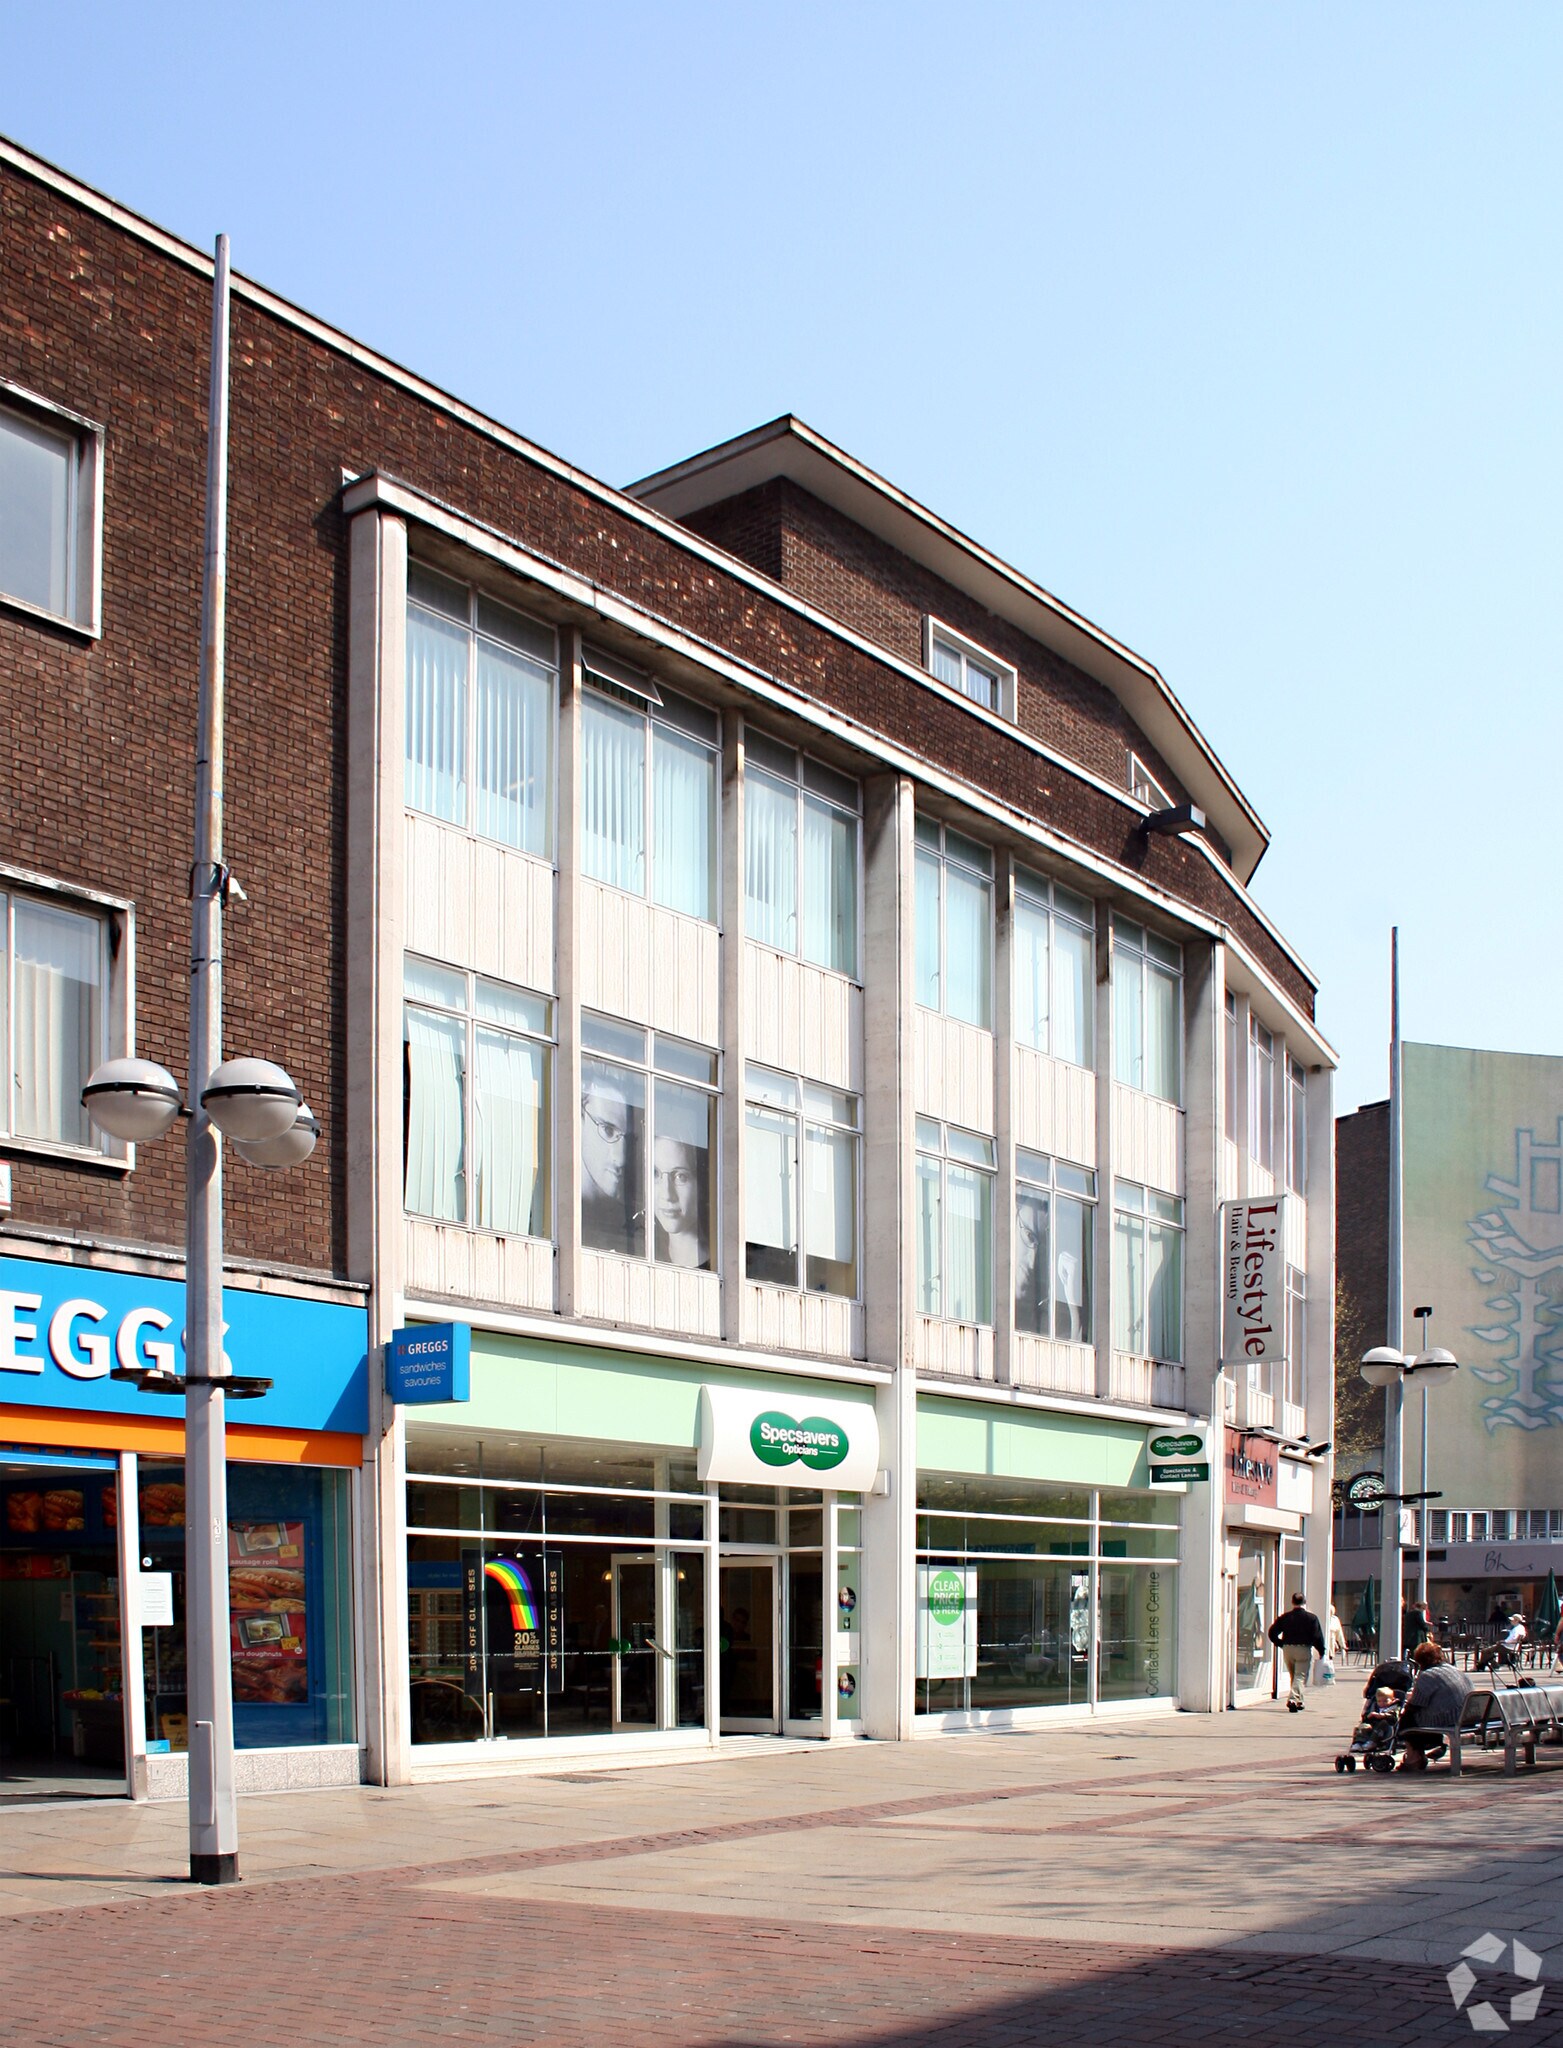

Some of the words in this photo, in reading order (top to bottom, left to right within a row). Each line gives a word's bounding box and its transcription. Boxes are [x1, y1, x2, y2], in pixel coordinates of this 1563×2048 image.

[1231, 1207, 1243, 1236] Hair
[1230, 1240, 1242, 1251] &
[1227, 1256, 1240, 1300] Beauty
[1236, 1202, 1279, 1357] Lifestyle
[0, 1288, 233, 1379] EGG
[408, 1340, 448, 1355] GREGGS
[400, 1361, 446, 1374] sandwiches
[404, 1376, 441, 1388] savouries
[760, 1422, 839, 1447] Specsavers
[782, 1443, 818, 1456] Opticians
[1156, 1440, 1198, 1448] Specsavers
[1485, 1551, 1534, 1572] Bhs
[933, 1580, 960, 1592] CLEAR
[1146, 1571, 1160, 1612] Centre
[933, 1592, 960, 1605] PRICE
[933, 1606, 941, 1615] IS
[941, 1606, 960, 1615] HERE
[1147, 1616, 1159, 1644] Lens
[1146, 1648, 1159, 1696] Contact
